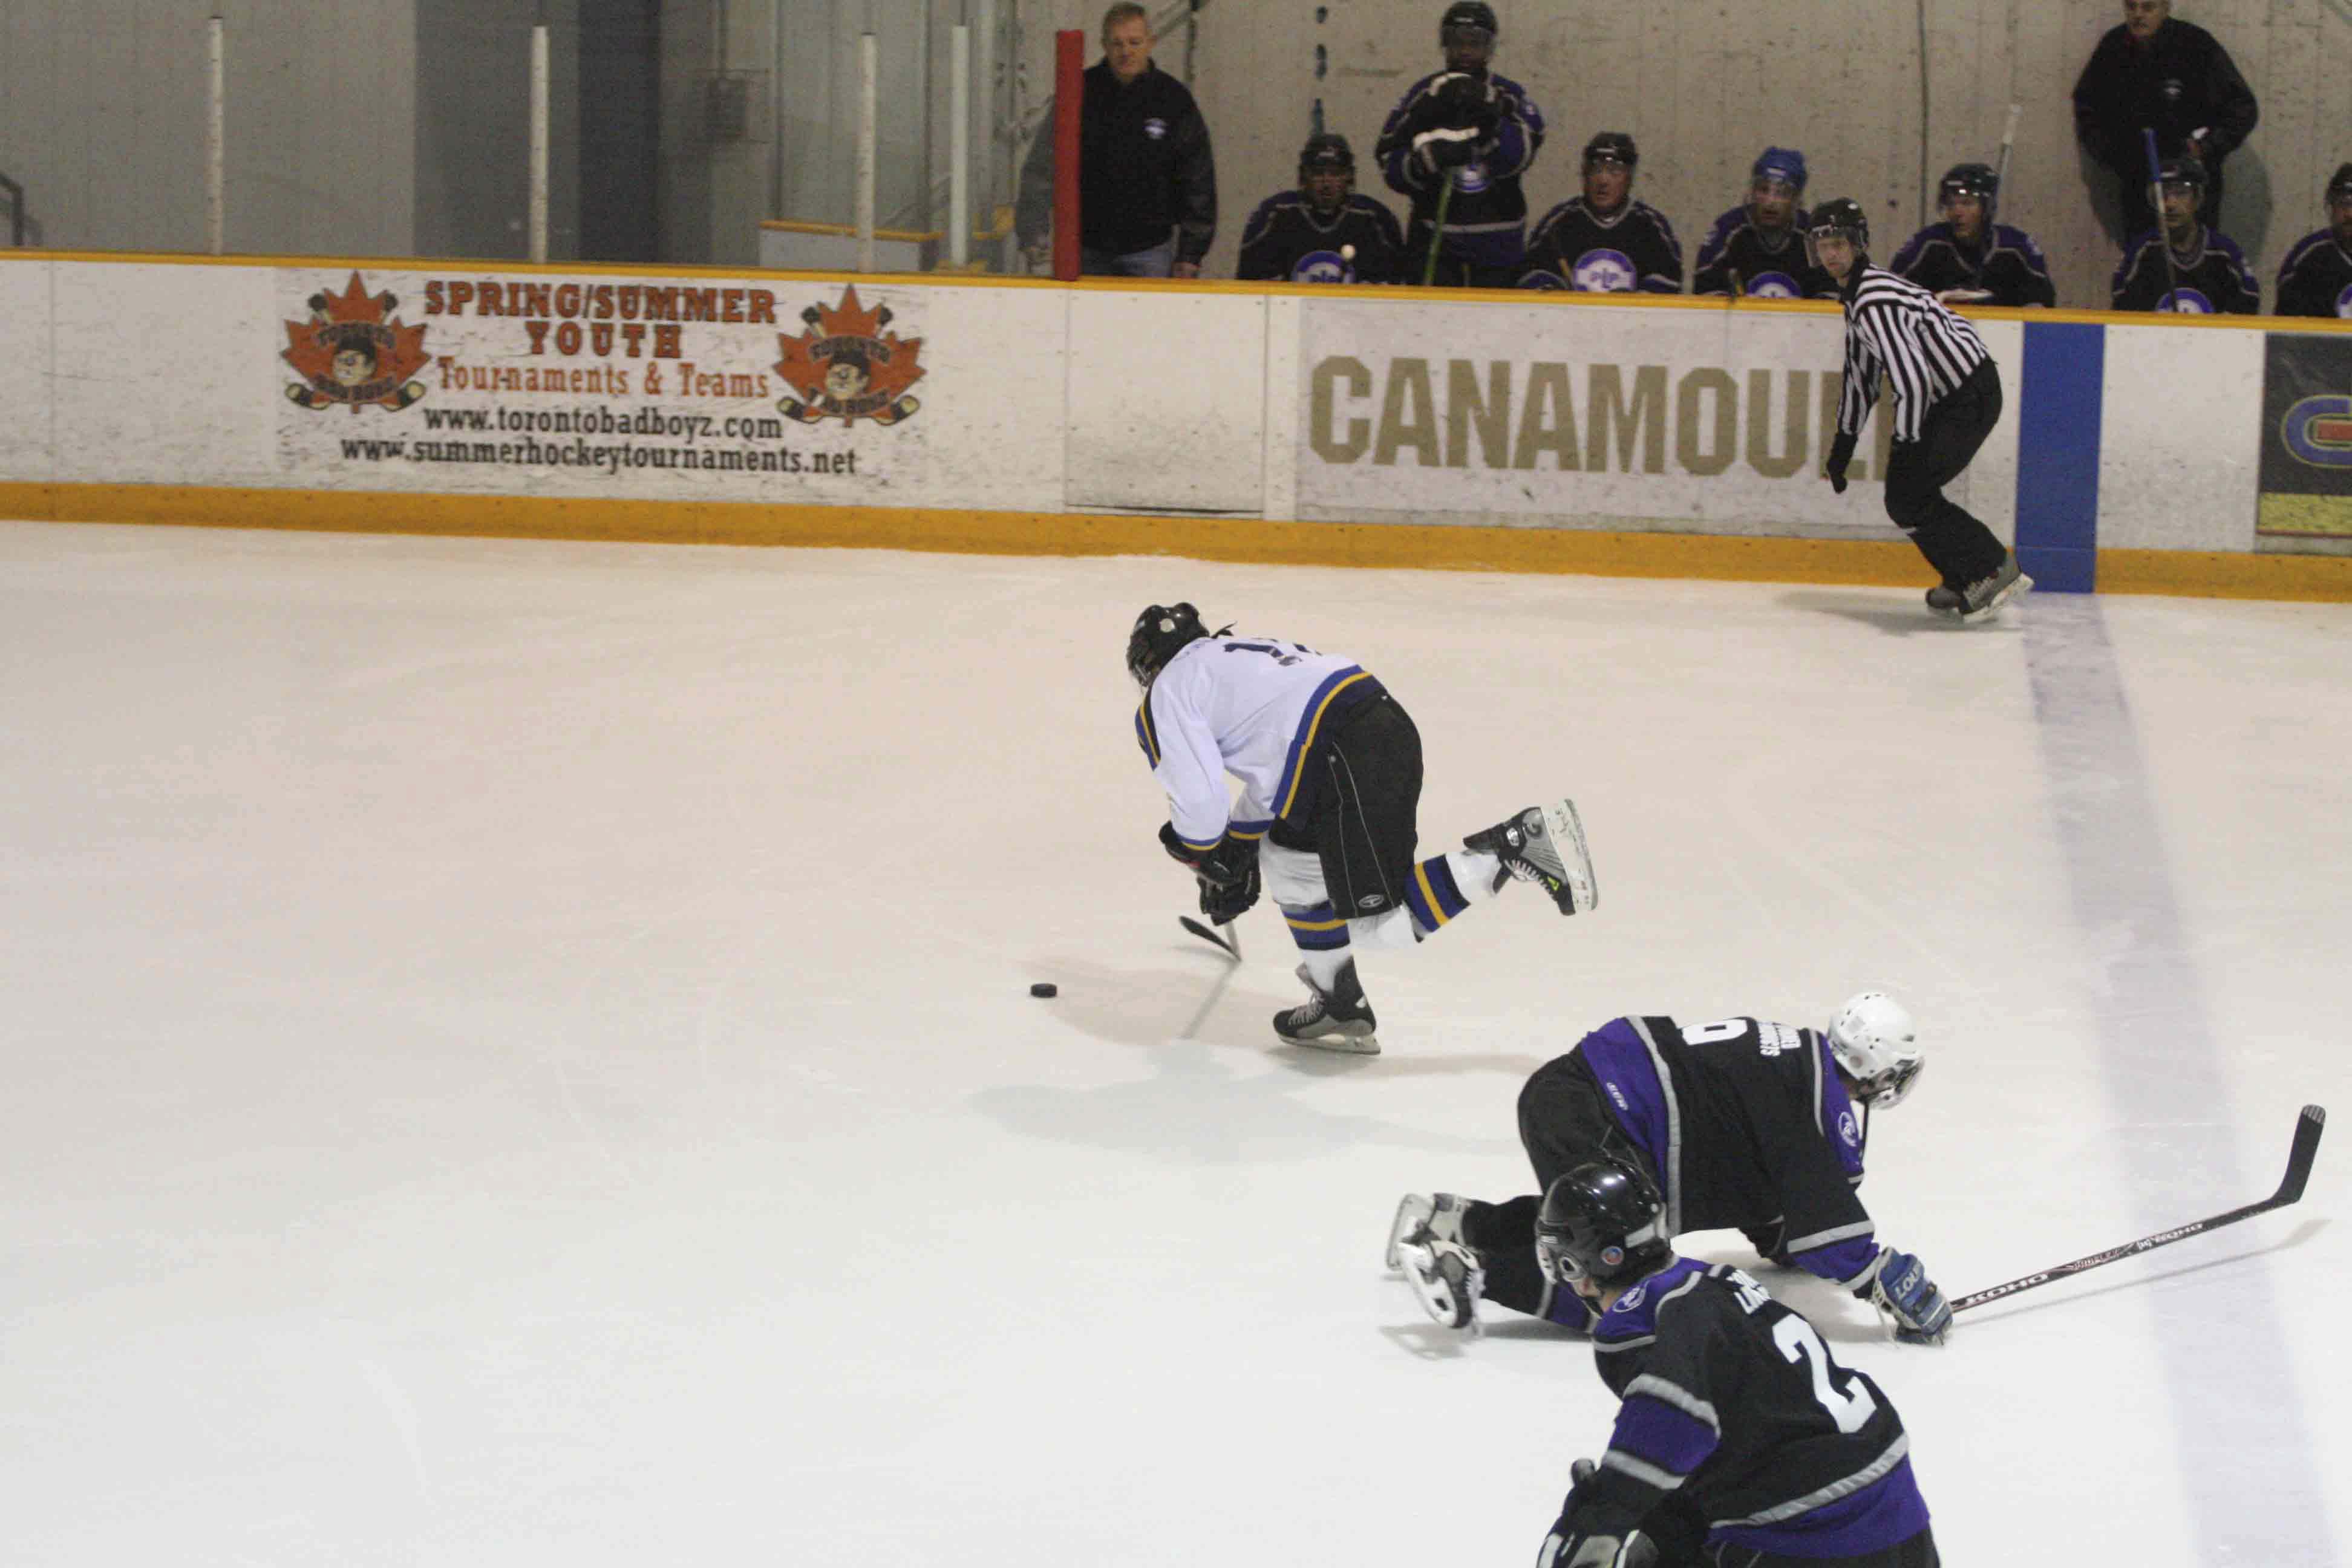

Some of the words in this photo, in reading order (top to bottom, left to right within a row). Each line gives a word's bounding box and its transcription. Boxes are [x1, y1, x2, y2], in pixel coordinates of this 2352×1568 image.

[425, 280, 777, 324] SPRING/SUMMER
[526, 321, 682, 359] YOUTH
[437, 356, 630, 394] Tournaments
[644, 361, 662, 396] &
[678, 363, 769, 397] Teams
[424, 405, 783, 444] www.torontobadboyz.com
[341, 436, 858, 475] www.summerhockeytournaments.net
[1966, 1273, 2048, 1305] KOHO
[1772, 1313, 1877, 1434] 2
